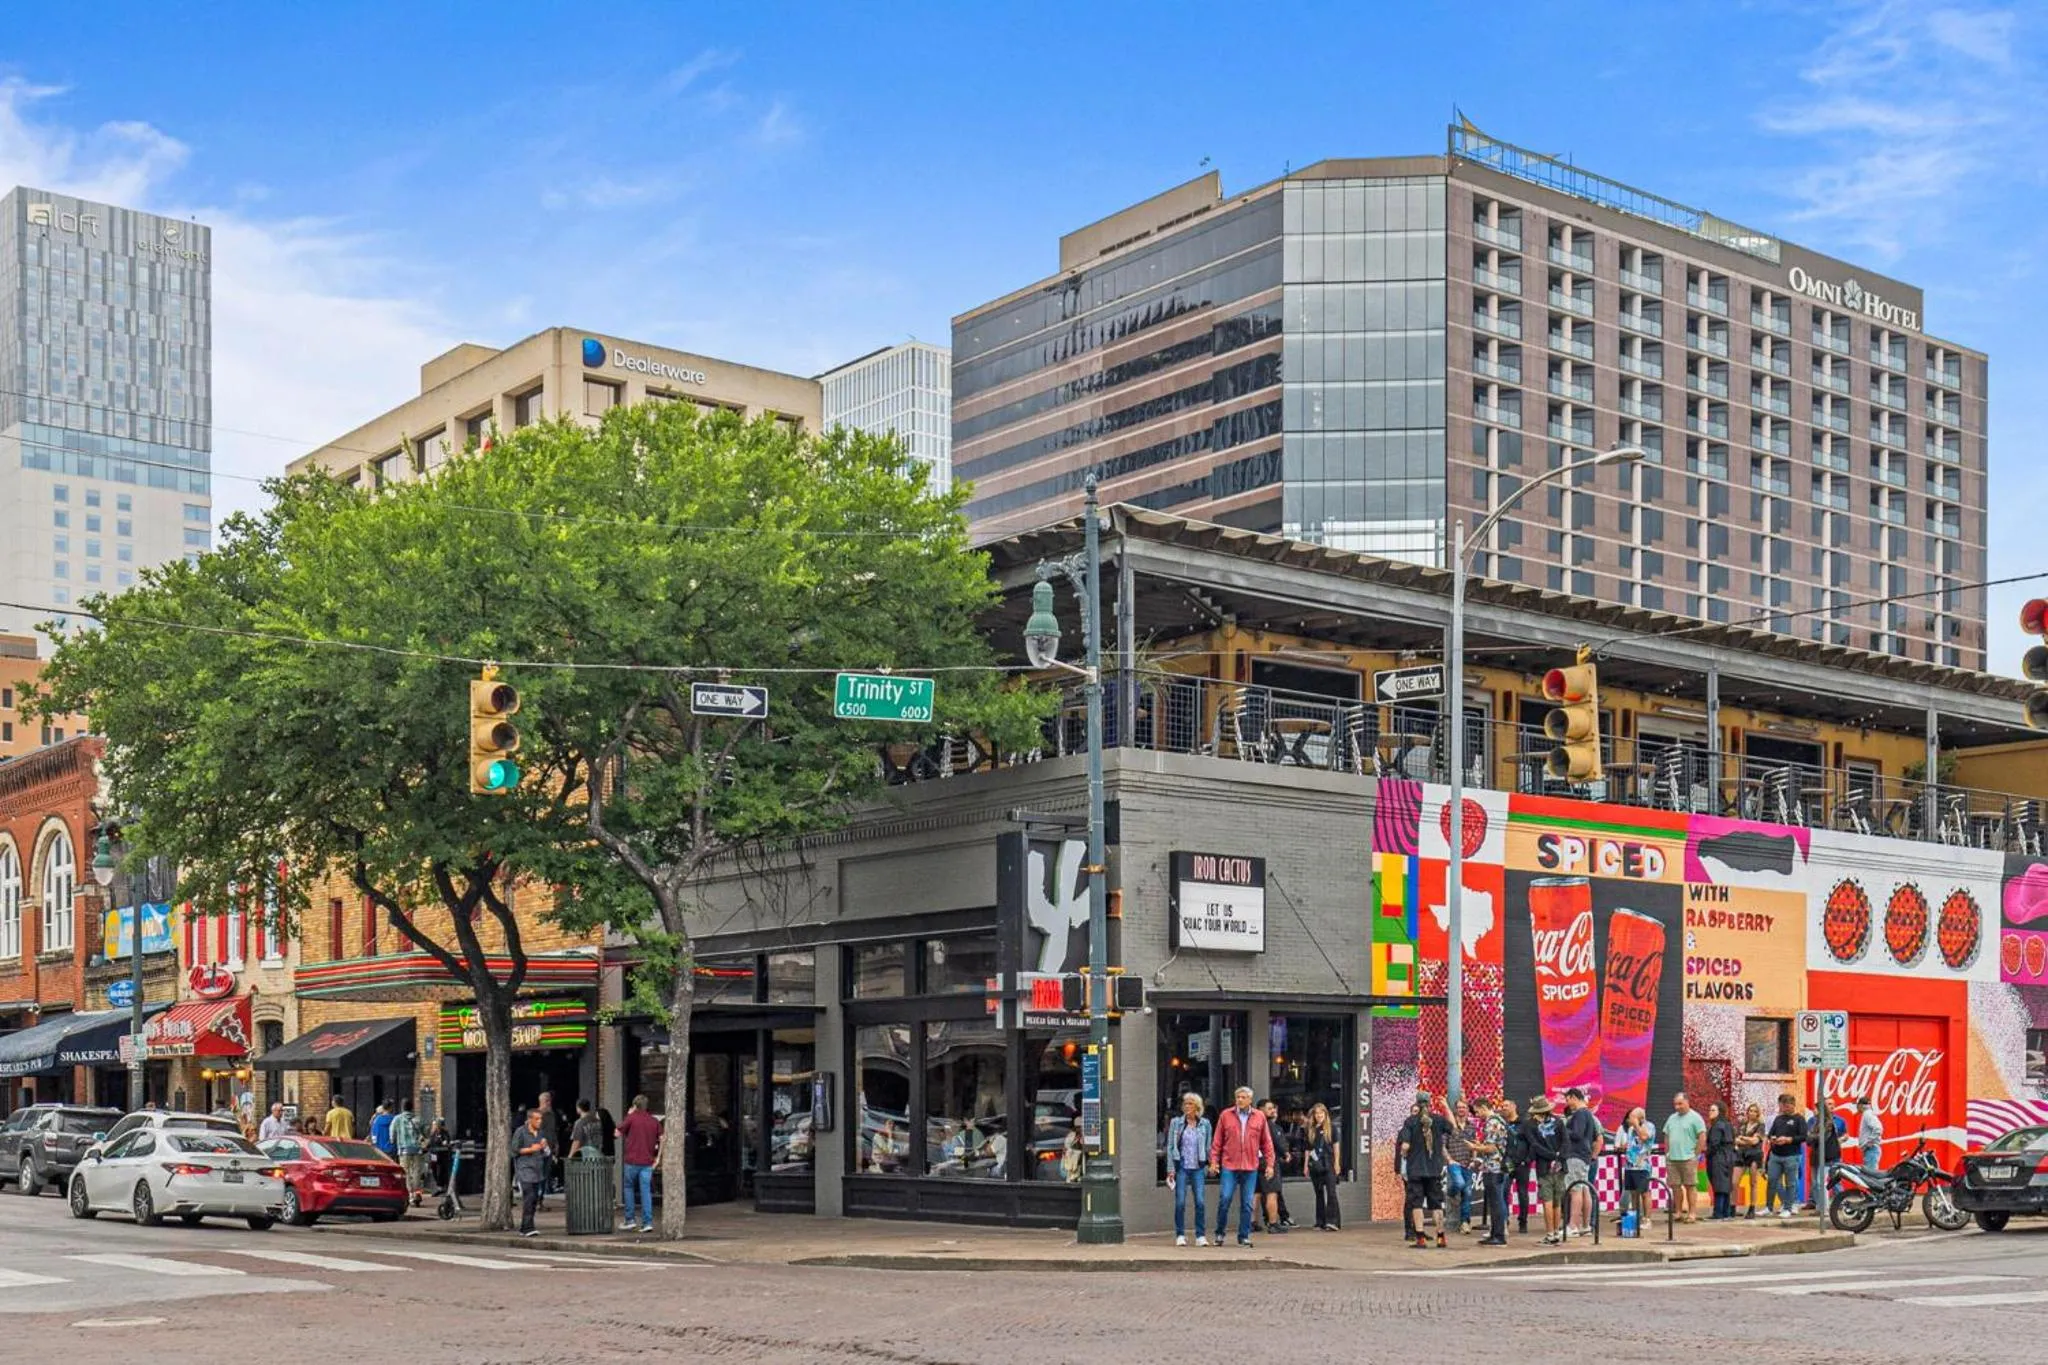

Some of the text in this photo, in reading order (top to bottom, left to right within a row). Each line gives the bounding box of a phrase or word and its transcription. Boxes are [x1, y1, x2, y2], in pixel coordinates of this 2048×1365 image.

[1863, 290, 1921, 332] HOTEL
[614, 349, 705, 384] Dealerware
[848, 677, 923, 705] Trinity ST
[1395, 675, 1437, 690] ONE WAY
[700, 693, 744, 705] ONE WAY
[846, 703, 867, 715] 500
[901, 706, 921, 718] 600
[1538, 833, 1667, 879] SPICED
[1194, 856, 1252, 884] IRON CACTUS
[1689, 884, 1729, 902] WITH
[1207, 903, 1233, 917] LET US
[1686, 908, 1775, 932] RASPBERRY
[1205, 919, 1221, 931] YOUR
[1223, 919, 1247, 933] WORLD
[1687, 930, 1696, 951] &
[1686, 957, 1742, 976] SPICED
[1542, 982, 1589, 1001] SPICED
[1687, 981, 1754, 1001] FLAVORS
[1610, 1002, 1652, 1023] SPICED
[1360, 1042, 1370, 1154] PASTE
